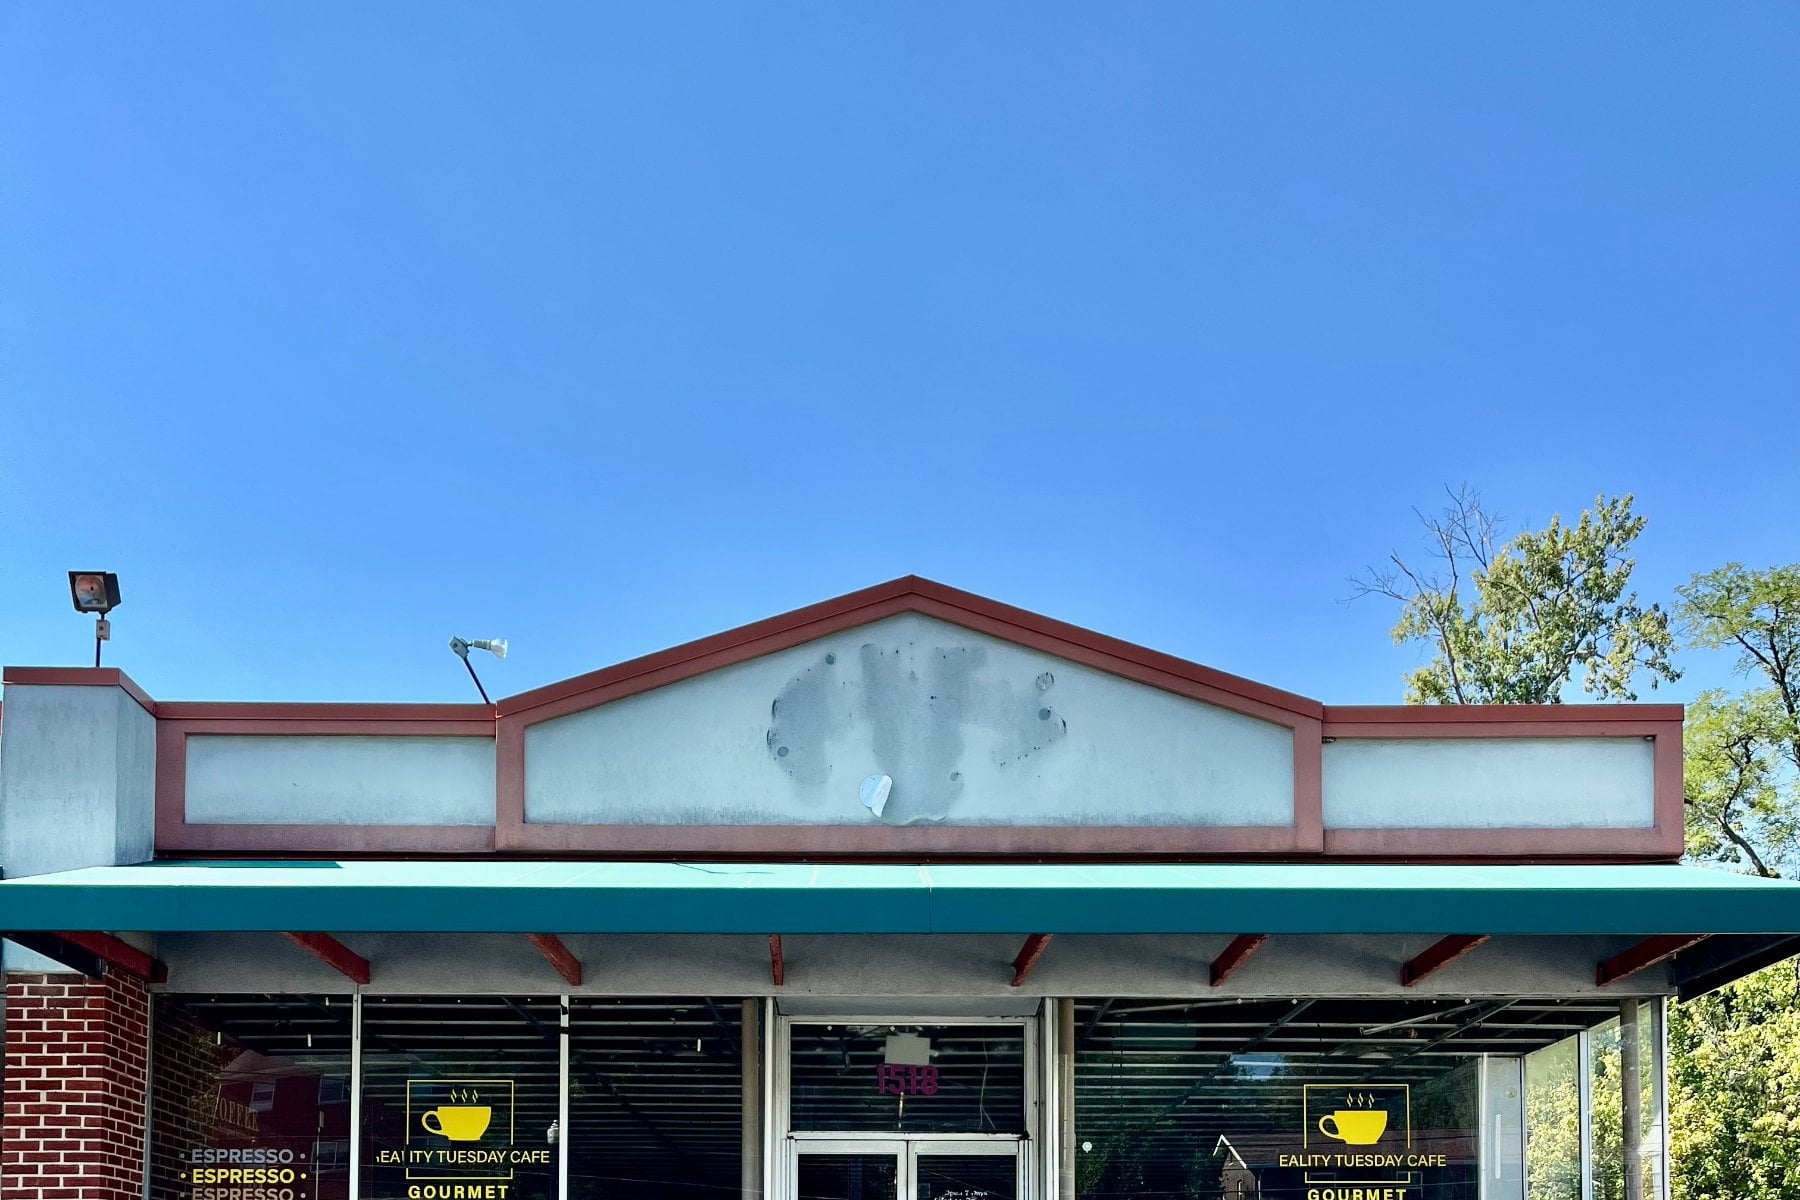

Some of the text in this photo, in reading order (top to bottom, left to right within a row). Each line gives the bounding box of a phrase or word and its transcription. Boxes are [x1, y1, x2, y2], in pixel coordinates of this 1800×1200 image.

[877, 1064, 939, 1096] 1518
[191, 1149, 294, 1164] ESPRESSO
[375, 1150, 551, 1164] EAITY TUESDAY CAFE
[1335, 1154, 1403, 1167] TUESDAY
[1407, 1154, 1447, 1167] CAFE
[192, 1168, 295, 1184] ESPRESSO
[408, 1185, 509, 1199] GOURMET
